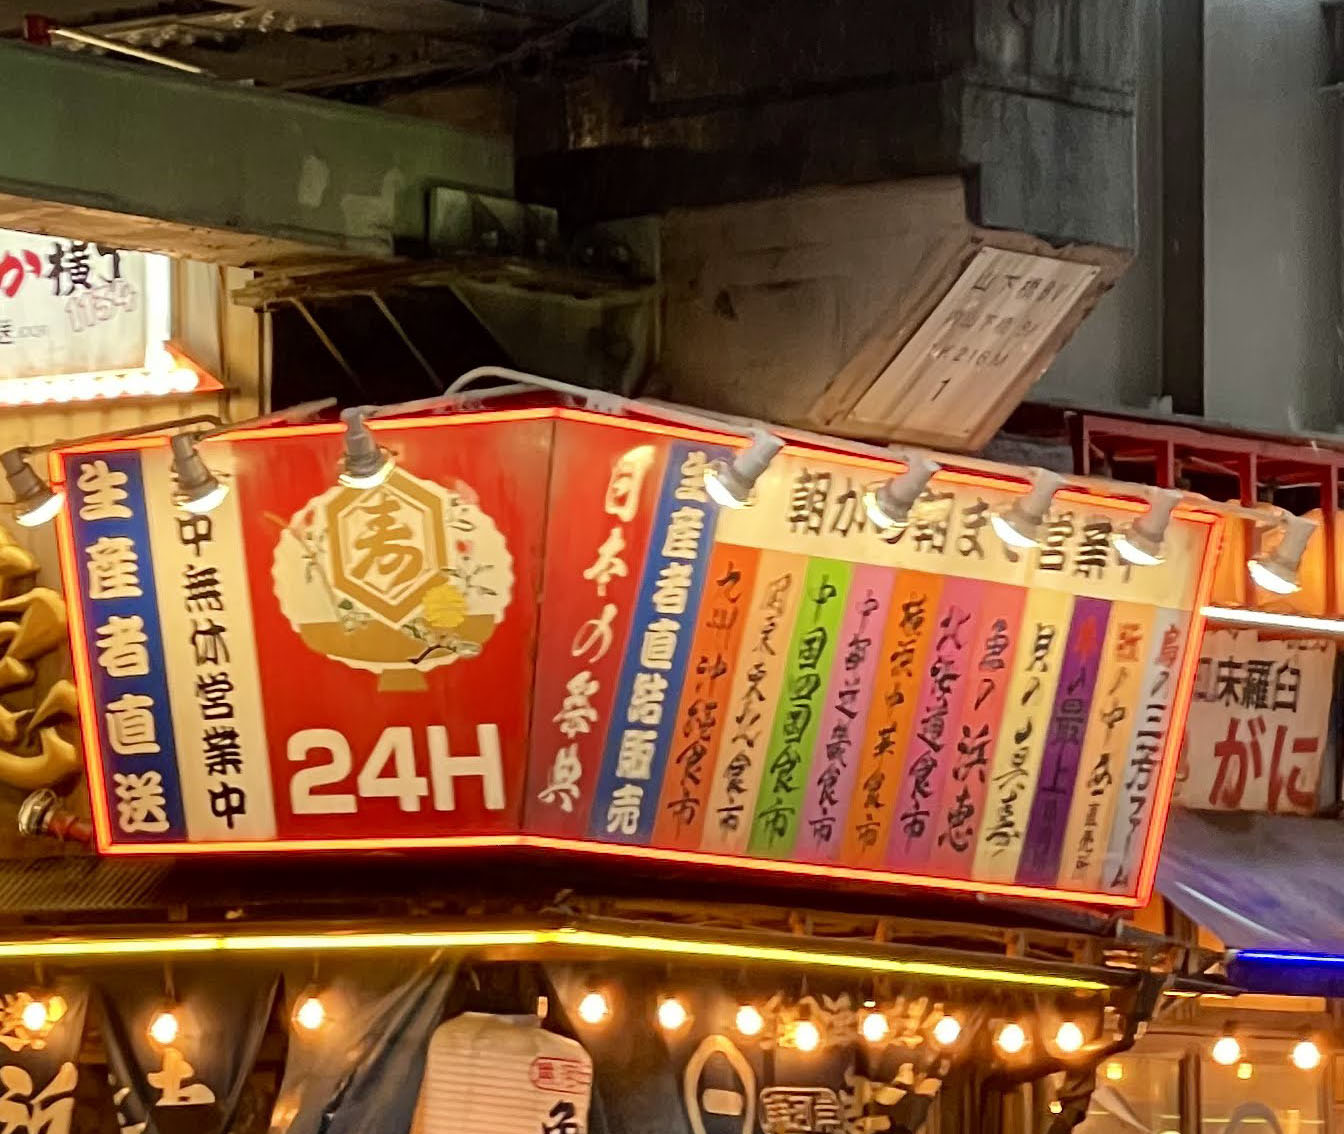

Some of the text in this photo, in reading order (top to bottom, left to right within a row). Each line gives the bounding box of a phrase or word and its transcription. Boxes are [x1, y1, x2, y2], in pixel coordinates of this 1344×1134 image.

[77, 459, 171, 834] 生産者直送
[176, 505, 248, 831] 中無休営業中
[285, 722, 506, 817] 24H
[1182, 716, 1320, 816] がに
